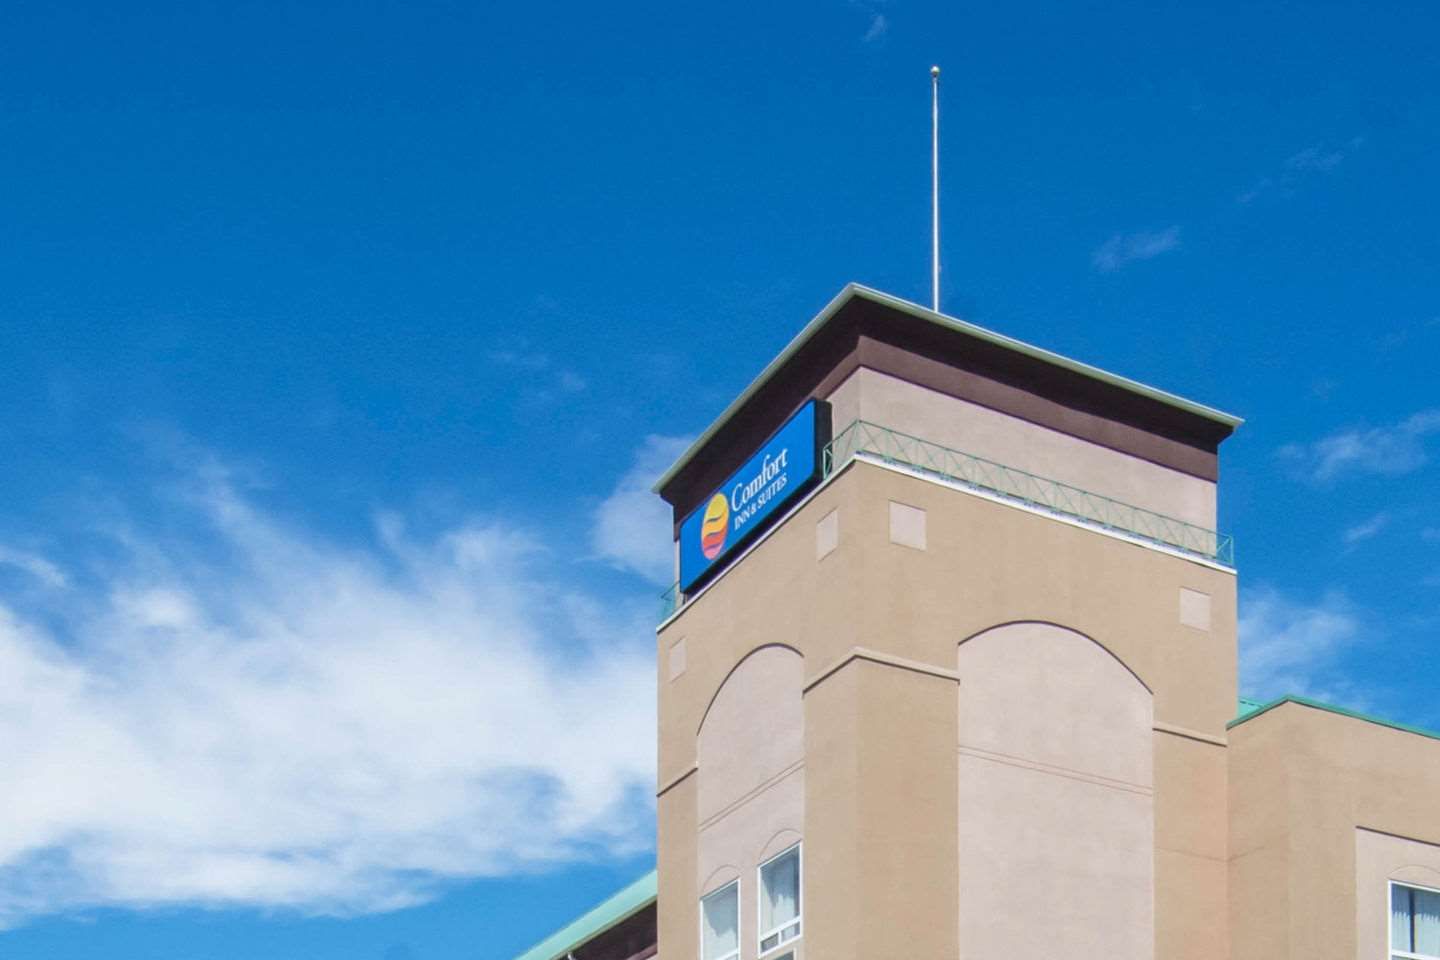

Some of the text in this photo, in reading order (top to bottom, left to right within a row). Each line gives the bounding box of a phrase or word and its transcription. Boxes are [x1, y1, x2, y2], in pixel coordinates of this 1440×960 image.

[732, 448, 788, 512] Comfort
[734, 505, 751, 531] INN
[757, 472, 787, 509] SUITES
